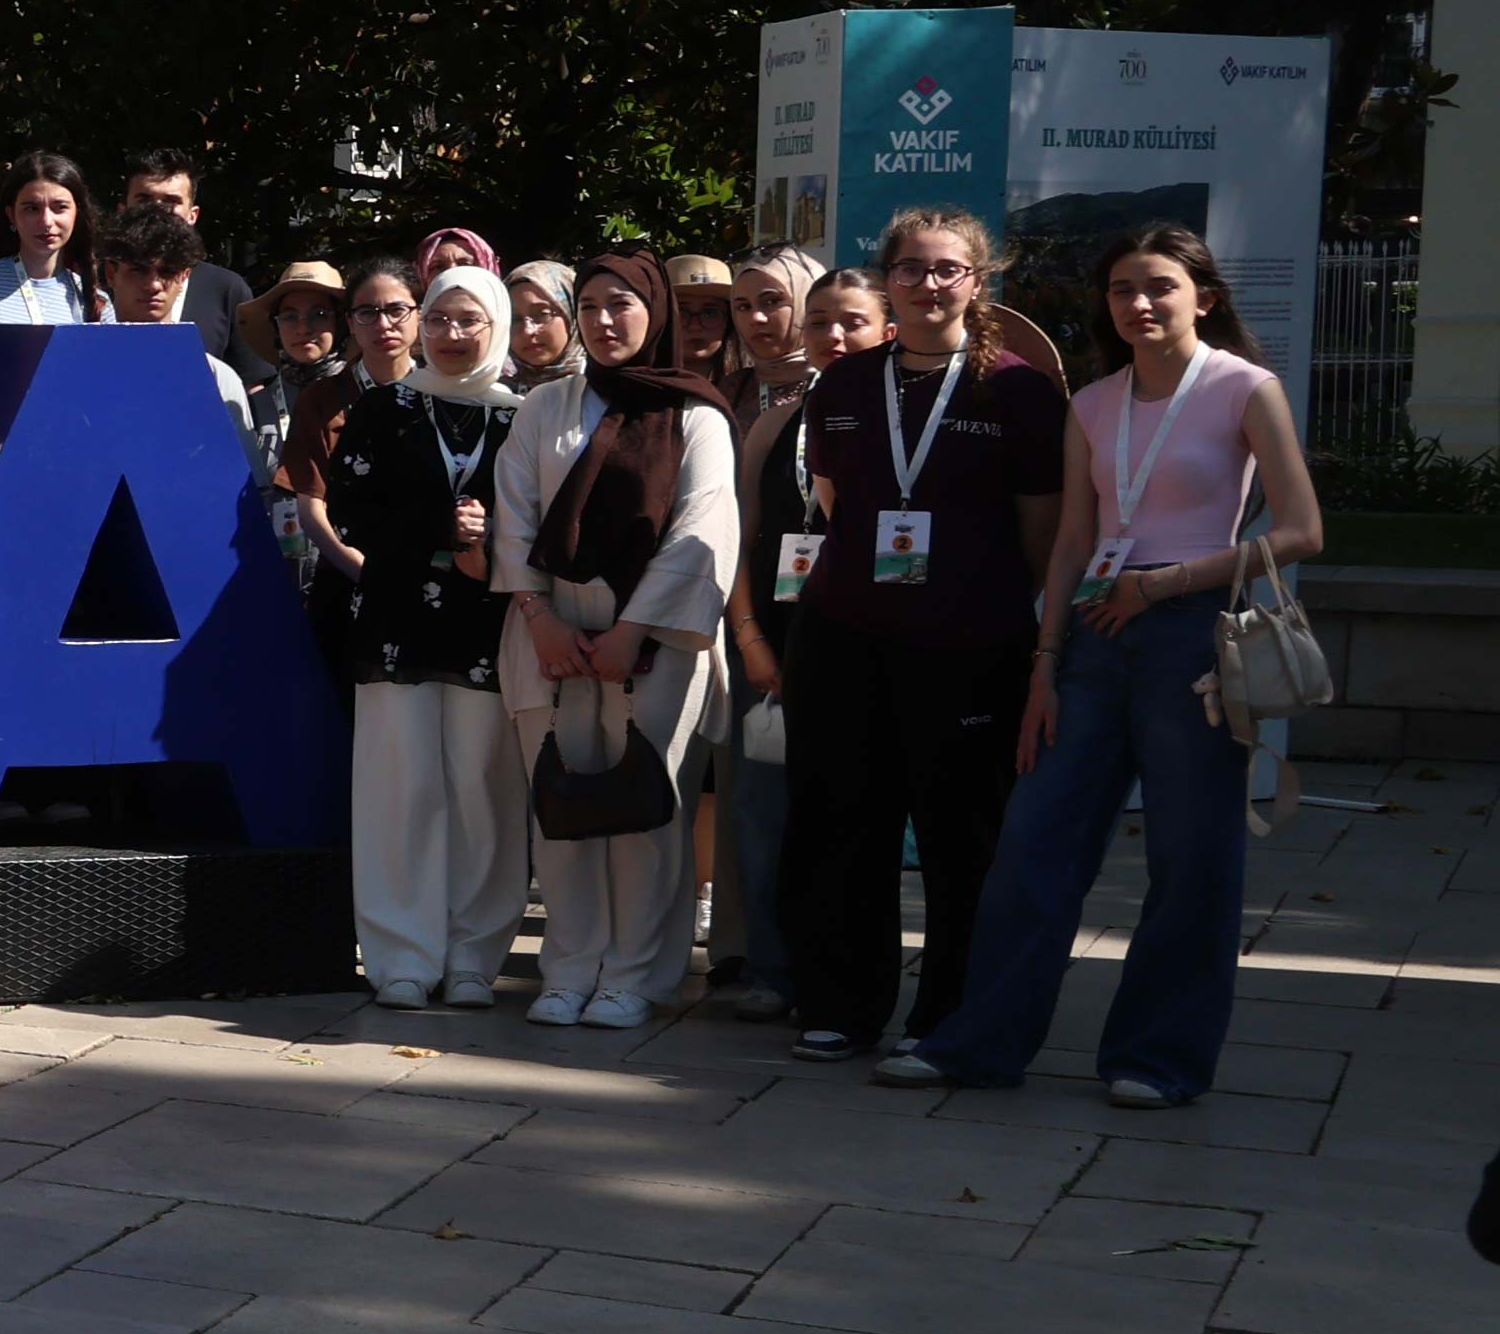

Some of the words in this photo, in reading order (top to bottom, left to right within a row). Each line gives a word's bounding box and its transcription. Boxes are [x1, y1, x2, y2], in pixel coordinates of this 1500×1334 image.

[1012, 59, 1047, 72] ATILIM
[1119, 59, 1147, 79] 700
[1240, 65, 1267, 78] VAKIF
[1268, 65, 1307, 79] KATILIM
[784, 101, 815, 124] MURAD
[890, 130, 960, 150] VAKIF
[1042, 128, 1062, 147] II.
[1065, 129, 1129, 149] MURAD
[1133, 125, 1216, 150] KÜLLİYESİ
[874, 152, 972, 173] KATILIM
[898, 538, 908, 549] 2
